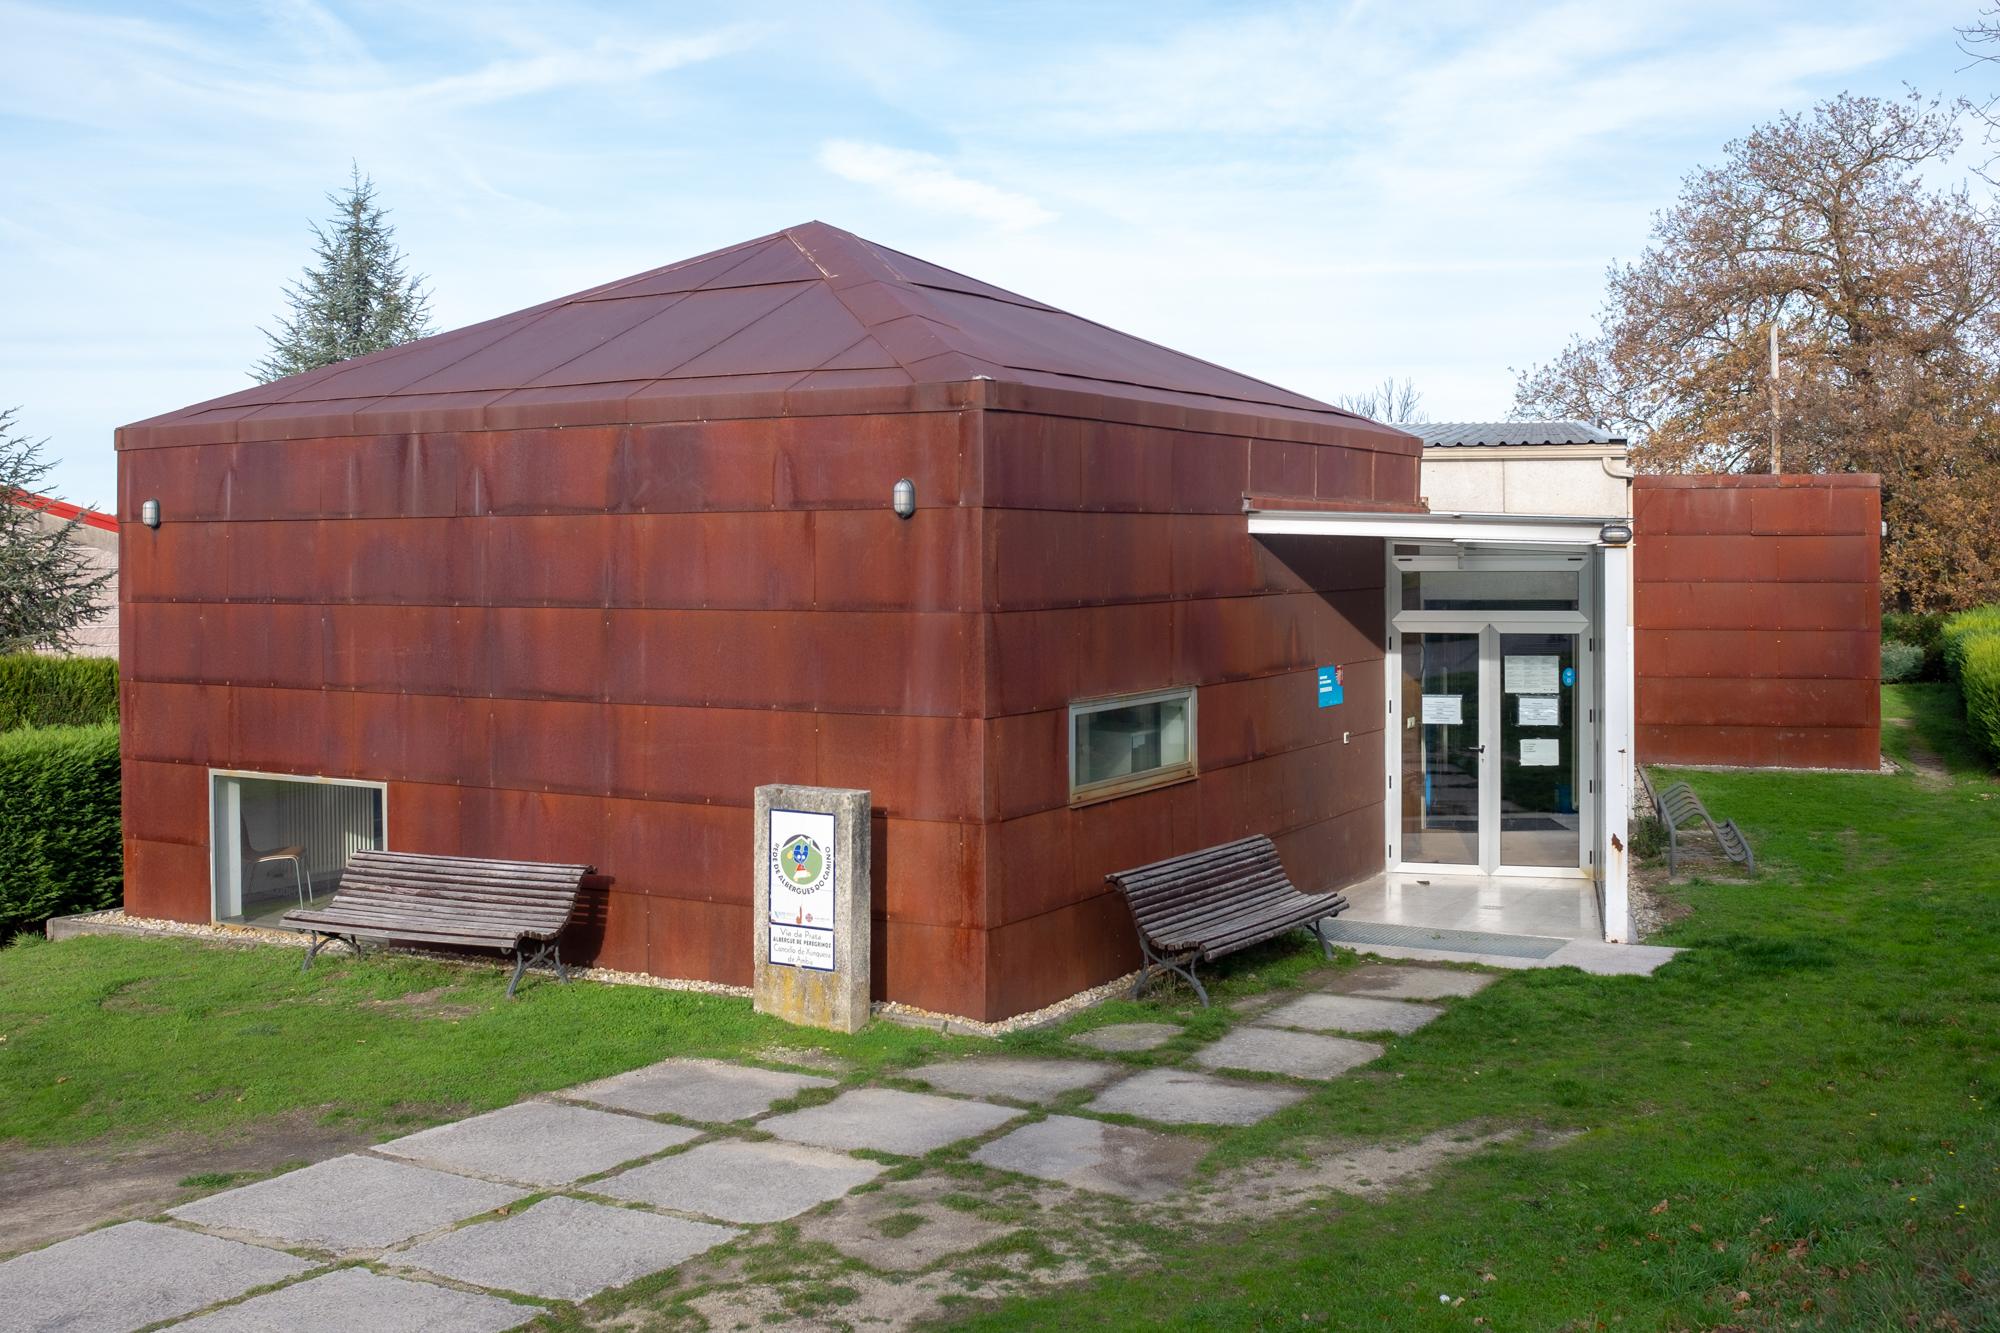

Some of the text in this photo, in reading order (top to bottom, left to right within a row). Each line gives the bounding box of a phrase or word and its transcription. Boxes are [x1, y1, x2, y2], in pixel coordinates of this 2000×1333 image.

[774, 864, 780, 874] DE
[778, 875, 815, 895] ALBERGUES
[814, 880, 825, 890] DO
[822, 846, 832, 880] CAMINO
[772, 936, 795, 944] ALBERGUE
[803, 940, 832, 949] PEREGRINOS
